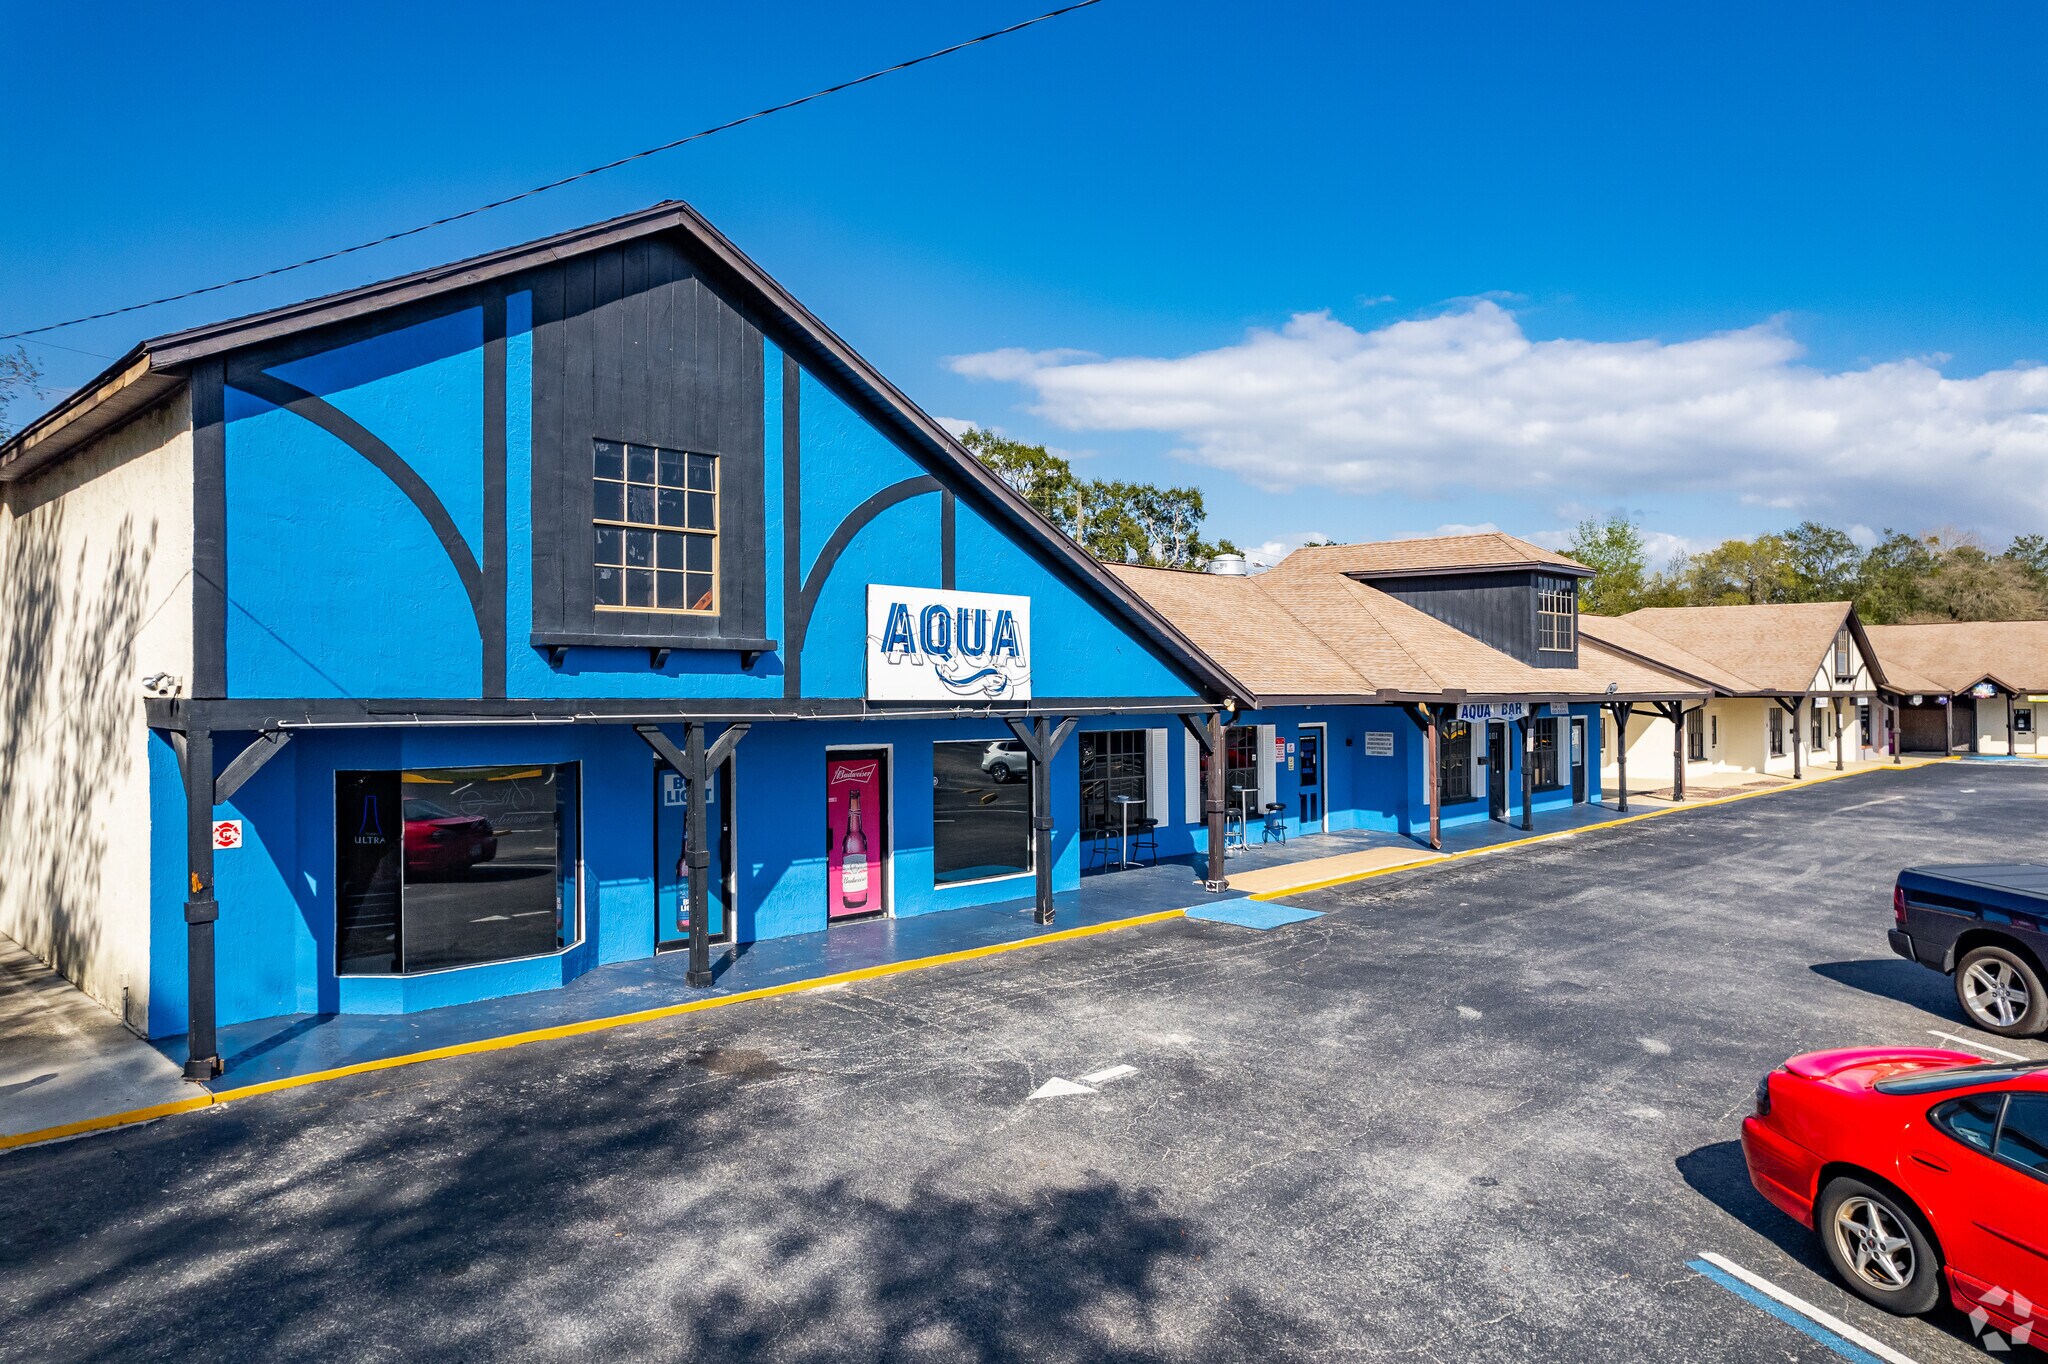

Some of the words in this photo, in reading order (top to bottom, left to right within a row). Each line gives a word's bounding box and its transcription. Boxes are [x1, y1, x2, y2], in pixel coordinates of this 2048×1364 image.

[880, 602, 1020, 662] AQUA
[1461, 704, 1491, 720] AQUA
[1502, 702, 1522, 716] BAR
[835, 769, 872, 780] Budweiser
[354, 836, 386, 844] ULTRA
